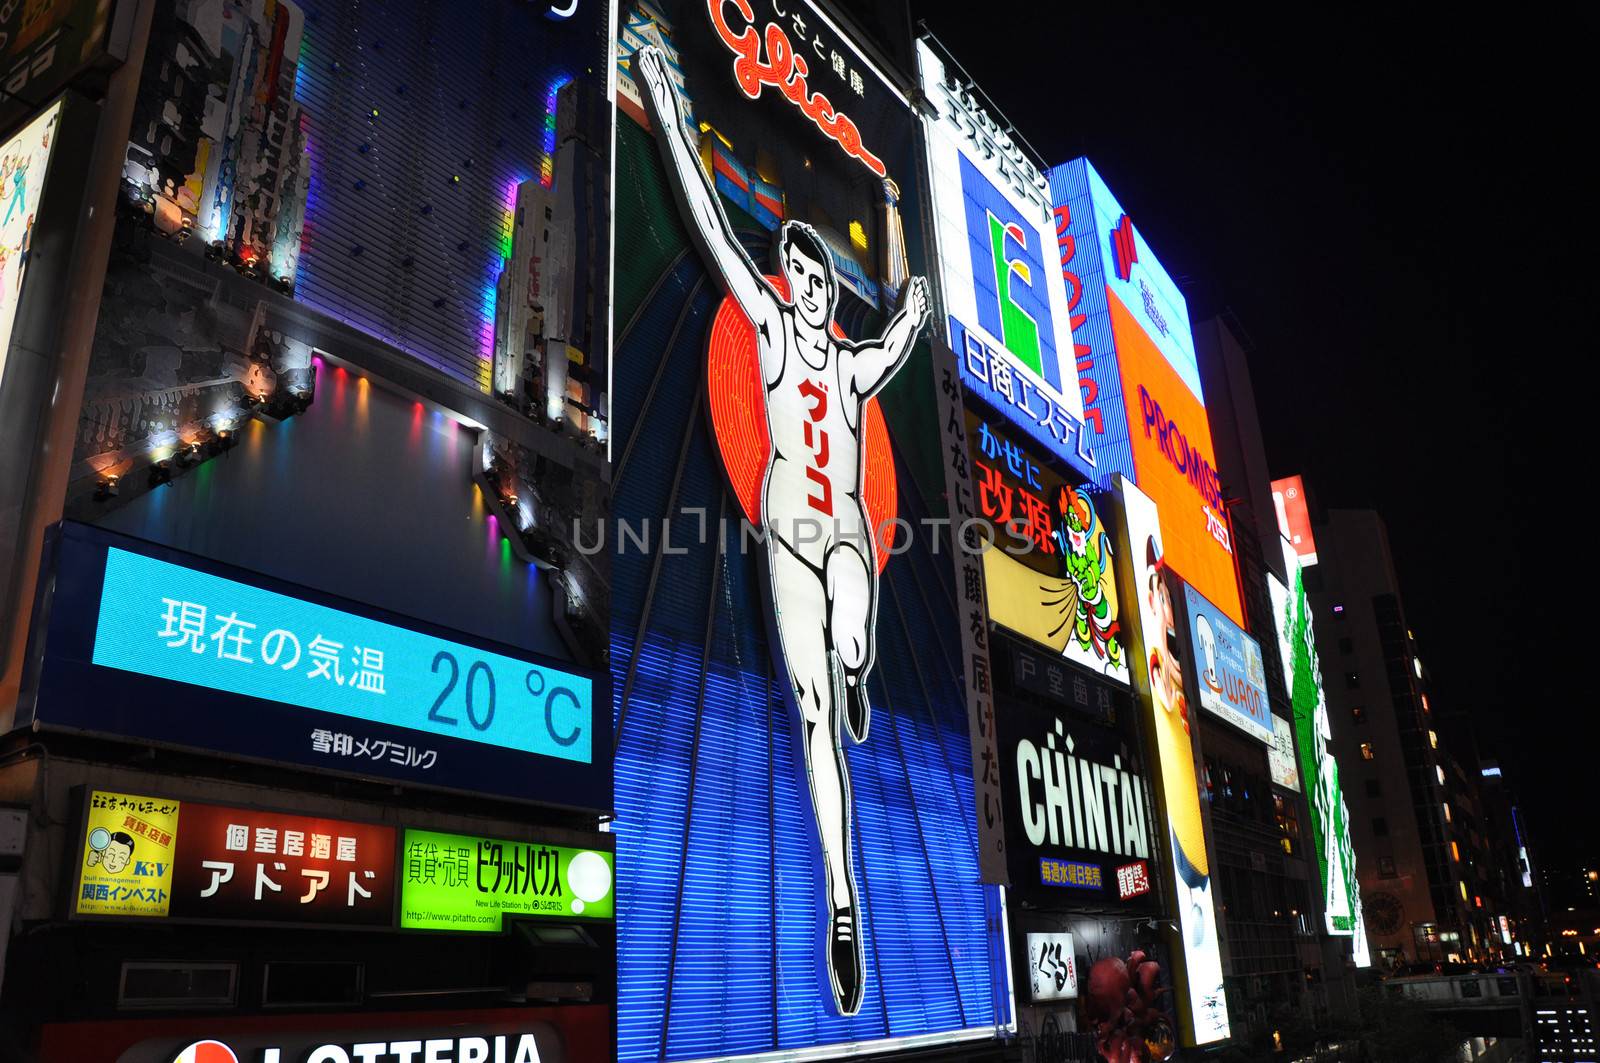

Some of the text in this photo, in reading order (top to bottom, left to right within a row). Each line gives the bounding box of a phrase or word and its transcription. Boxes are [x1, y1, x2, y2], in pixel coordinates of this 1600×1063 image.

[707, 0, 886, 177] Glico
[963, 326, 1097, 468] 日商エステム
[797, 378, 833, 517] グリコ
[978, 420, 1043, 491] かぜに
[1137, 383, 1227, 521] PROMISE
[975, 460, 1056, 555] 改源
[157, 597, 386, 696] 現在の気温
[428, 650, 496, 732] 20
[310, 728, 437, 769] 雪印メグミルク
[1017, 738, 1149, 858] CHINTAI
[226, 824, 357, 862] 個室居酒屋
[408, 841, 470, 888] 賃貸・売買
[476, 840, 562, 897] ピタットハウス
[1041, 861, 1102, 887] 毎週水曜日発売
[81, 883, 167, 903] 関西インベスト
[200, 860, 375, 906] アドアド
[490, 900, 501, 908] Life
[502, 901, 522, 909] Station
[524, 902, 531, 910] by
